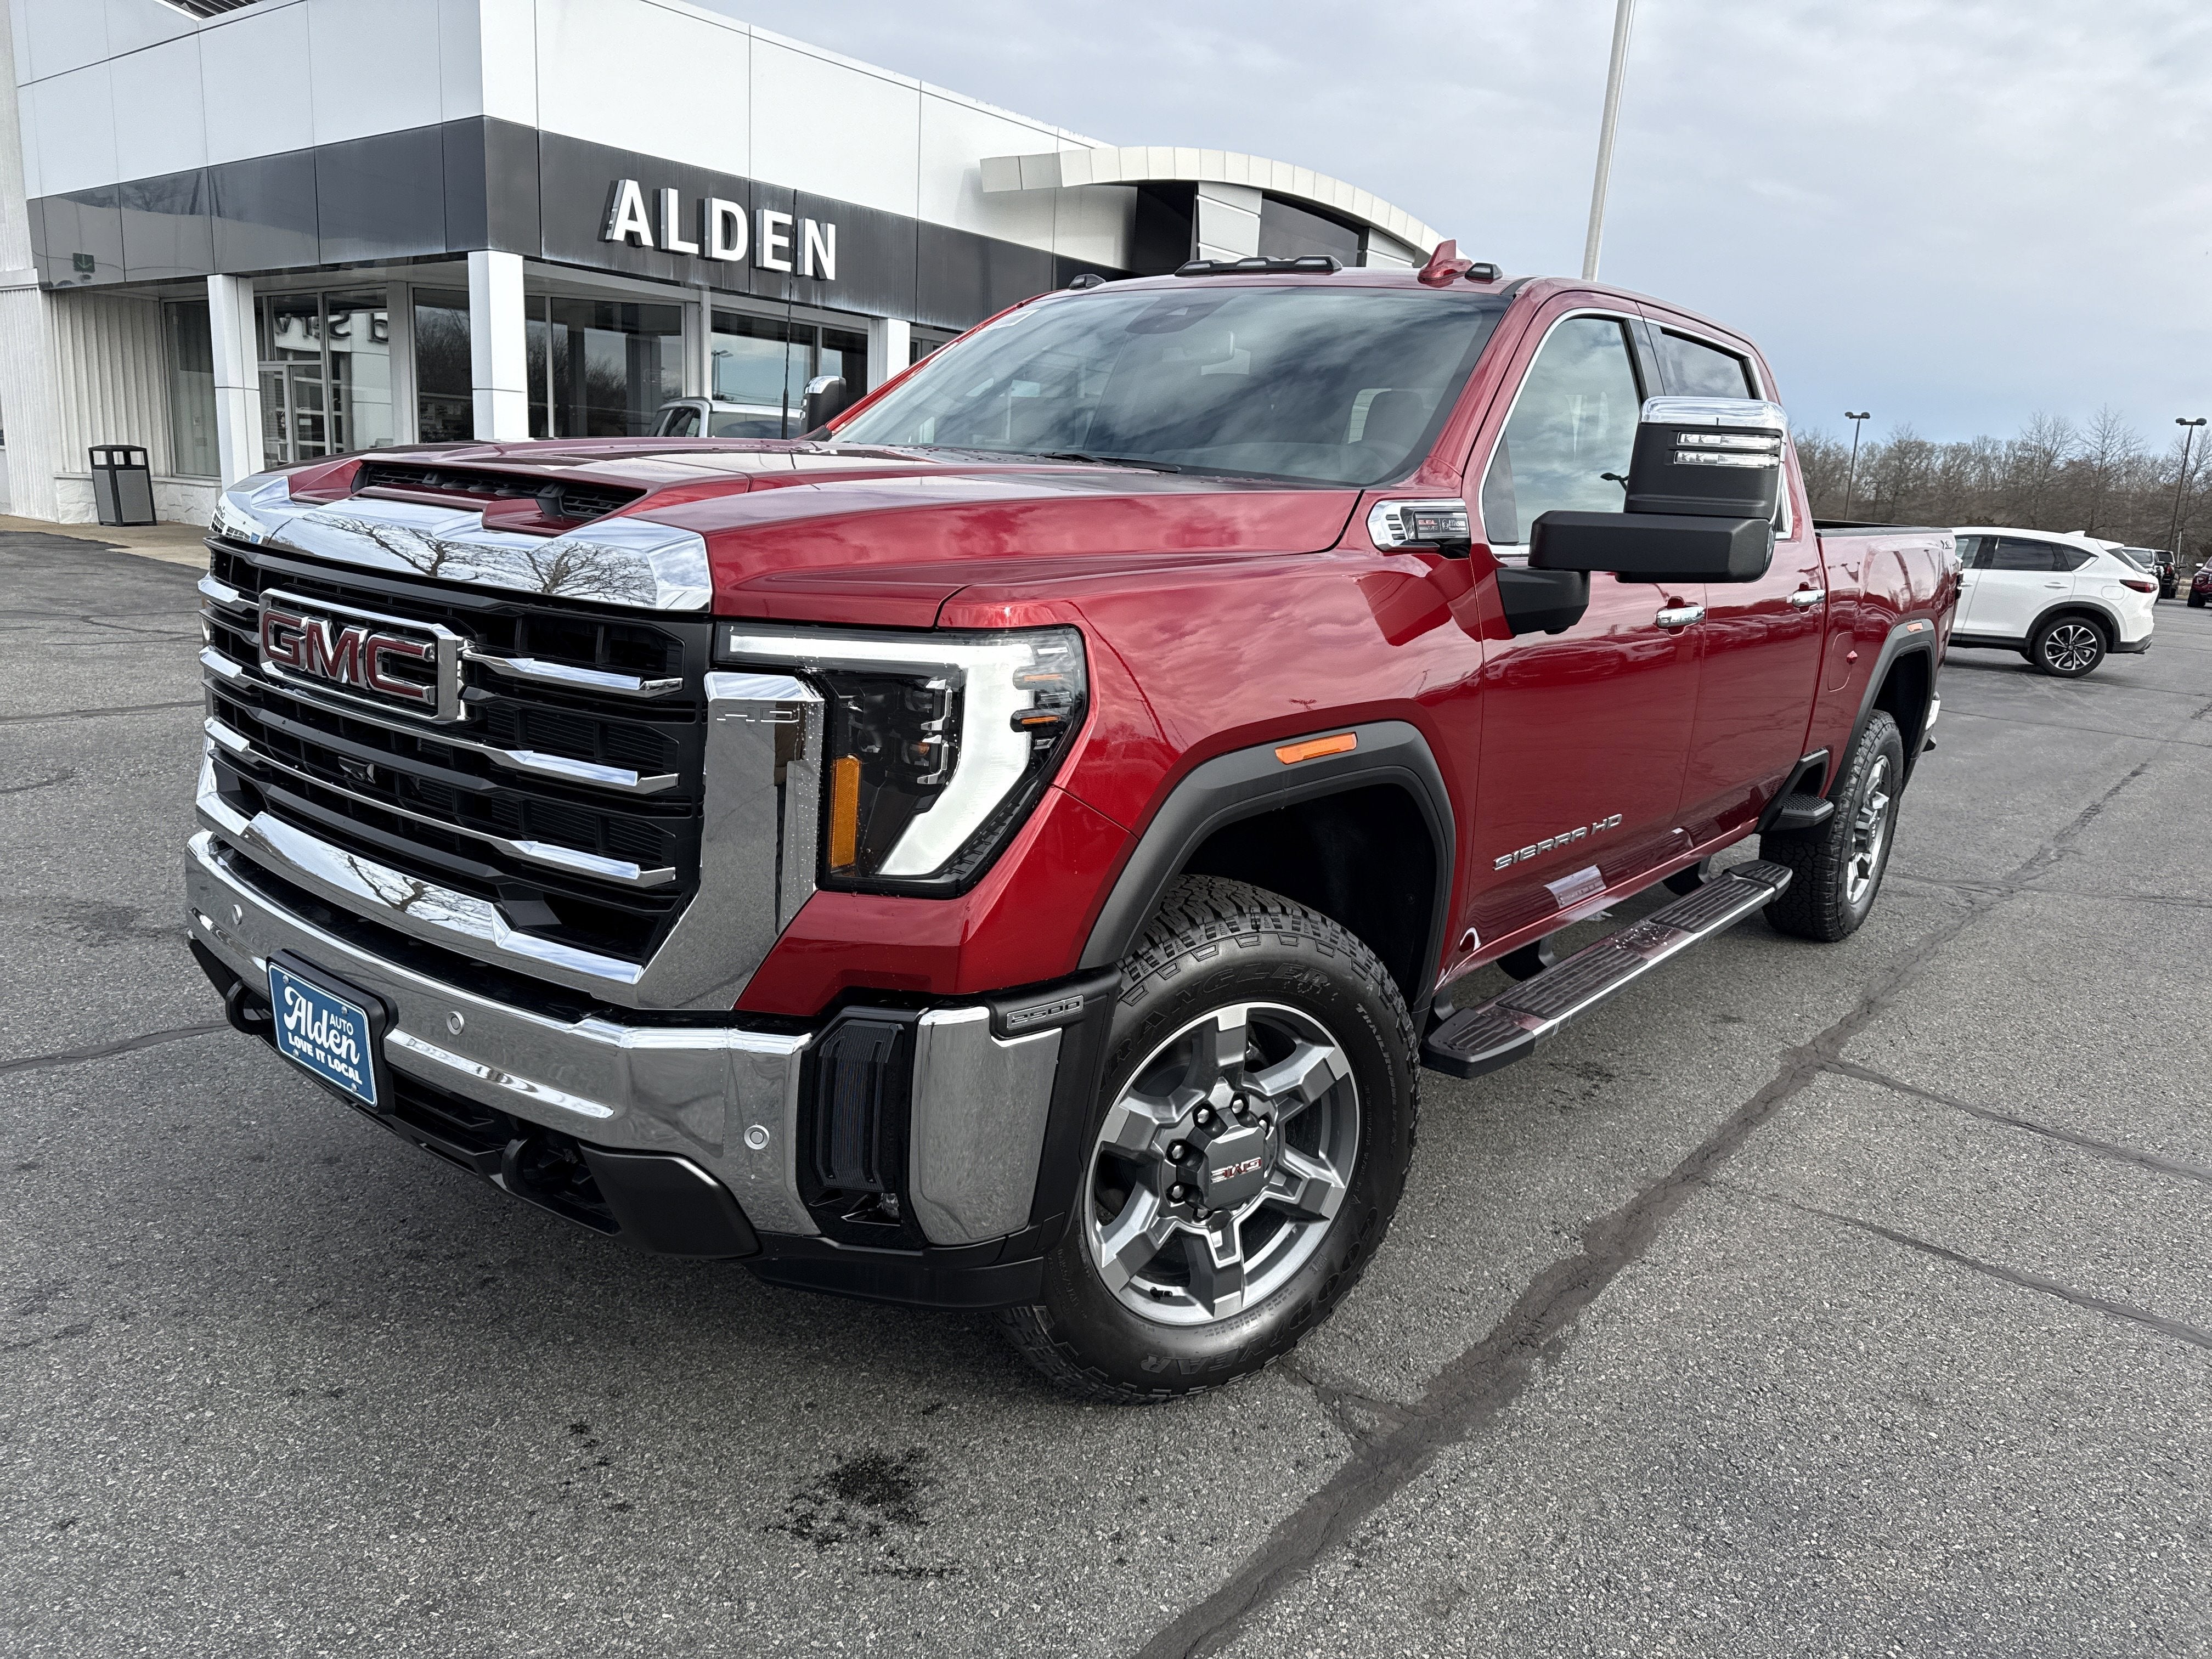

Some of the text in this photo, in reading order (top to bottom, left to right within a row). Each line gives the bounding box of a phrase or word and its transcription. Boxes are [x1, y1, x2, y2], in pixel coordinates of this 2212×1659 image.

[605, 179, 836, 280] ALDEN
[262, 608, 435, 705] GMC
[1492, 814, 1622, 871] SIERRA HD
[284, 986, 360, 1065] Alden
[329, 1013, 354, 1036] AUTO
[1011, 1001, 1080, 1025] 2500
[1098, 963, 1329, 1092] RANGLER
[287, 1031, 363, 1085] LOVE IT LOCAL
[1139, 1207, 1378, 1375] GOODYEAR
